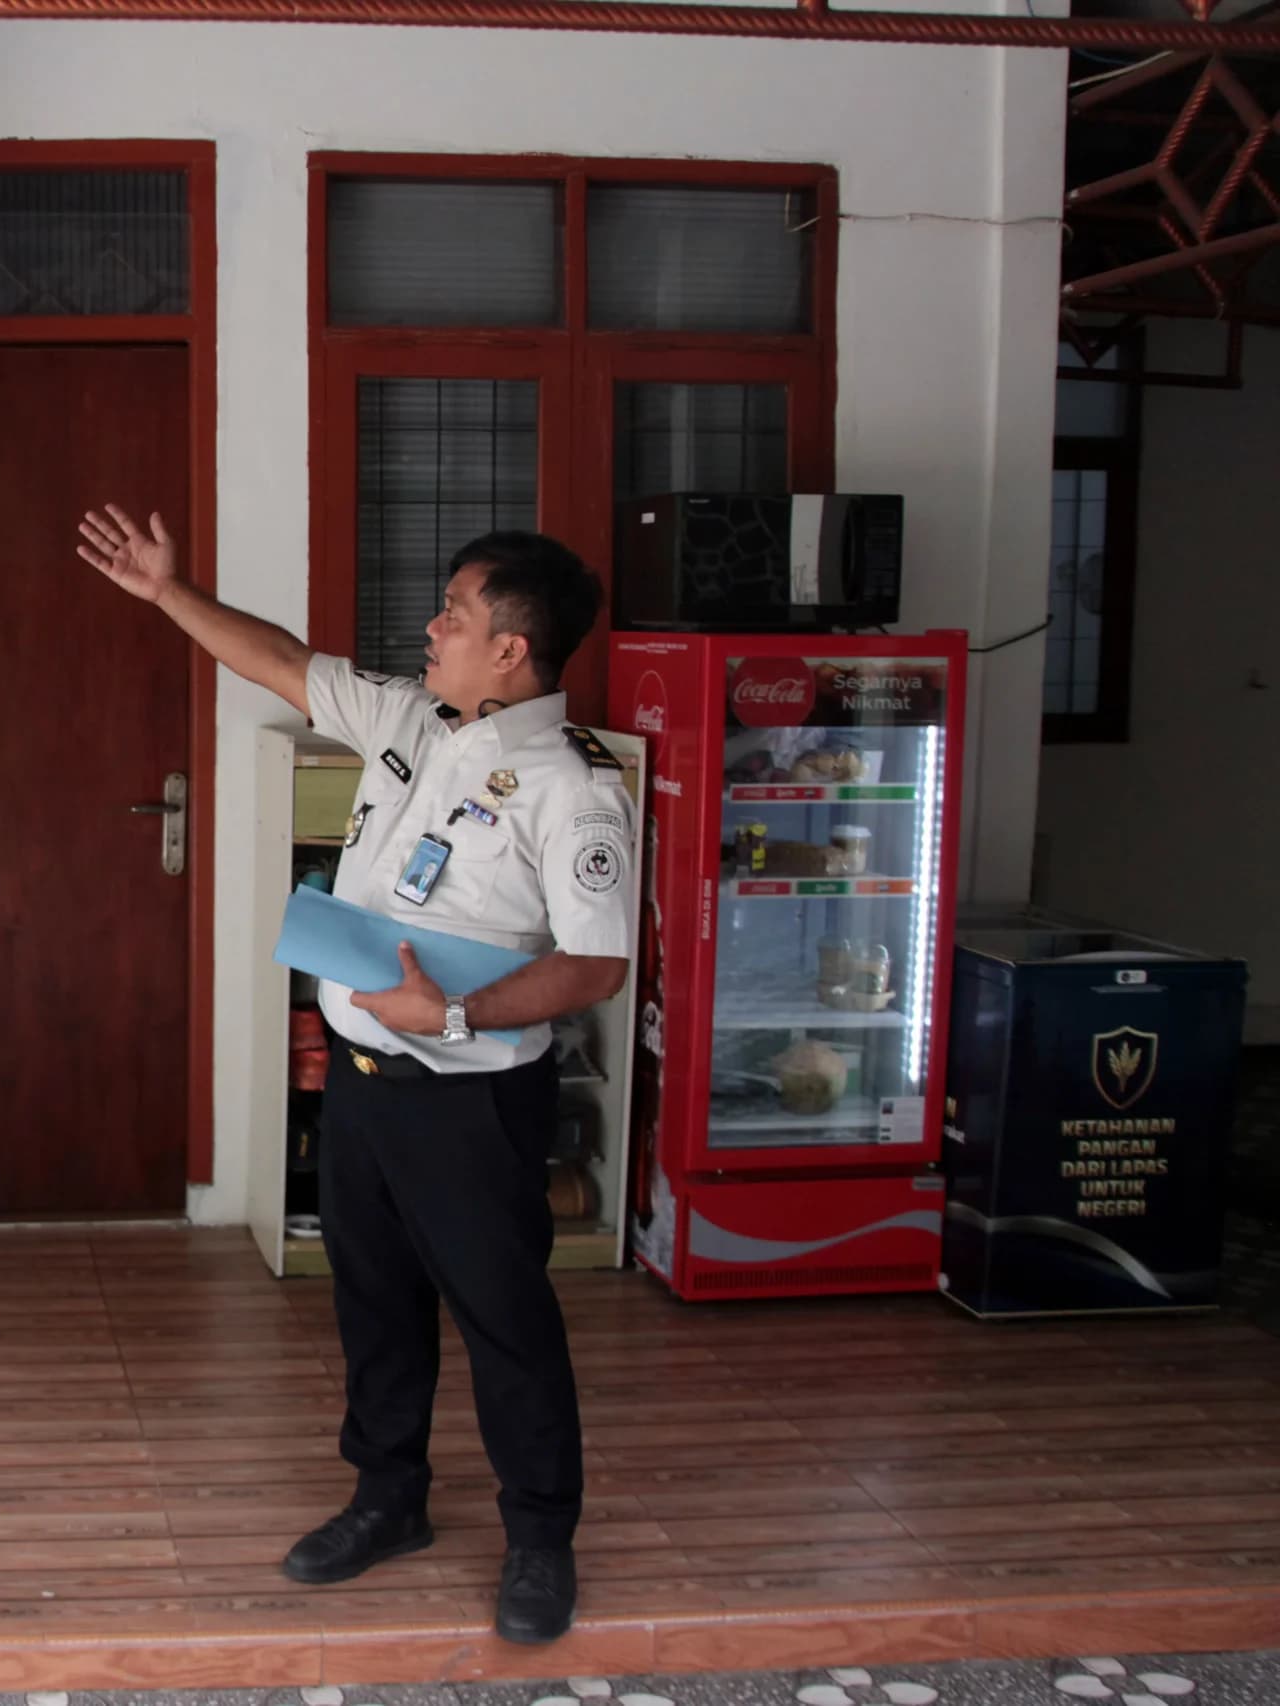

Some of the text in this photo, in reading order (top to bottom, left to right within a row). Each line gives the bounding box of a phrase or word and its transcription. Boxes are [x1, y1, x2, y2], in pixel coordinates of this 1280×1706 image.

[734, 678, 807, 704] Coca-Cola
[833, 674, 923, 692] Segarnya
[842, 695, 912, 711] Nikmat
[1061, 1118, 1176, 1136] KETAHANAN
[1077, 1139, 1157, 1156] PANGAN
[1061, 1158, 1169, 1177] DARI LAPAS
[1080, 1180, 1145, 1197] UNTUK
[1076, 1200, 1146, 1217] NEGERI
